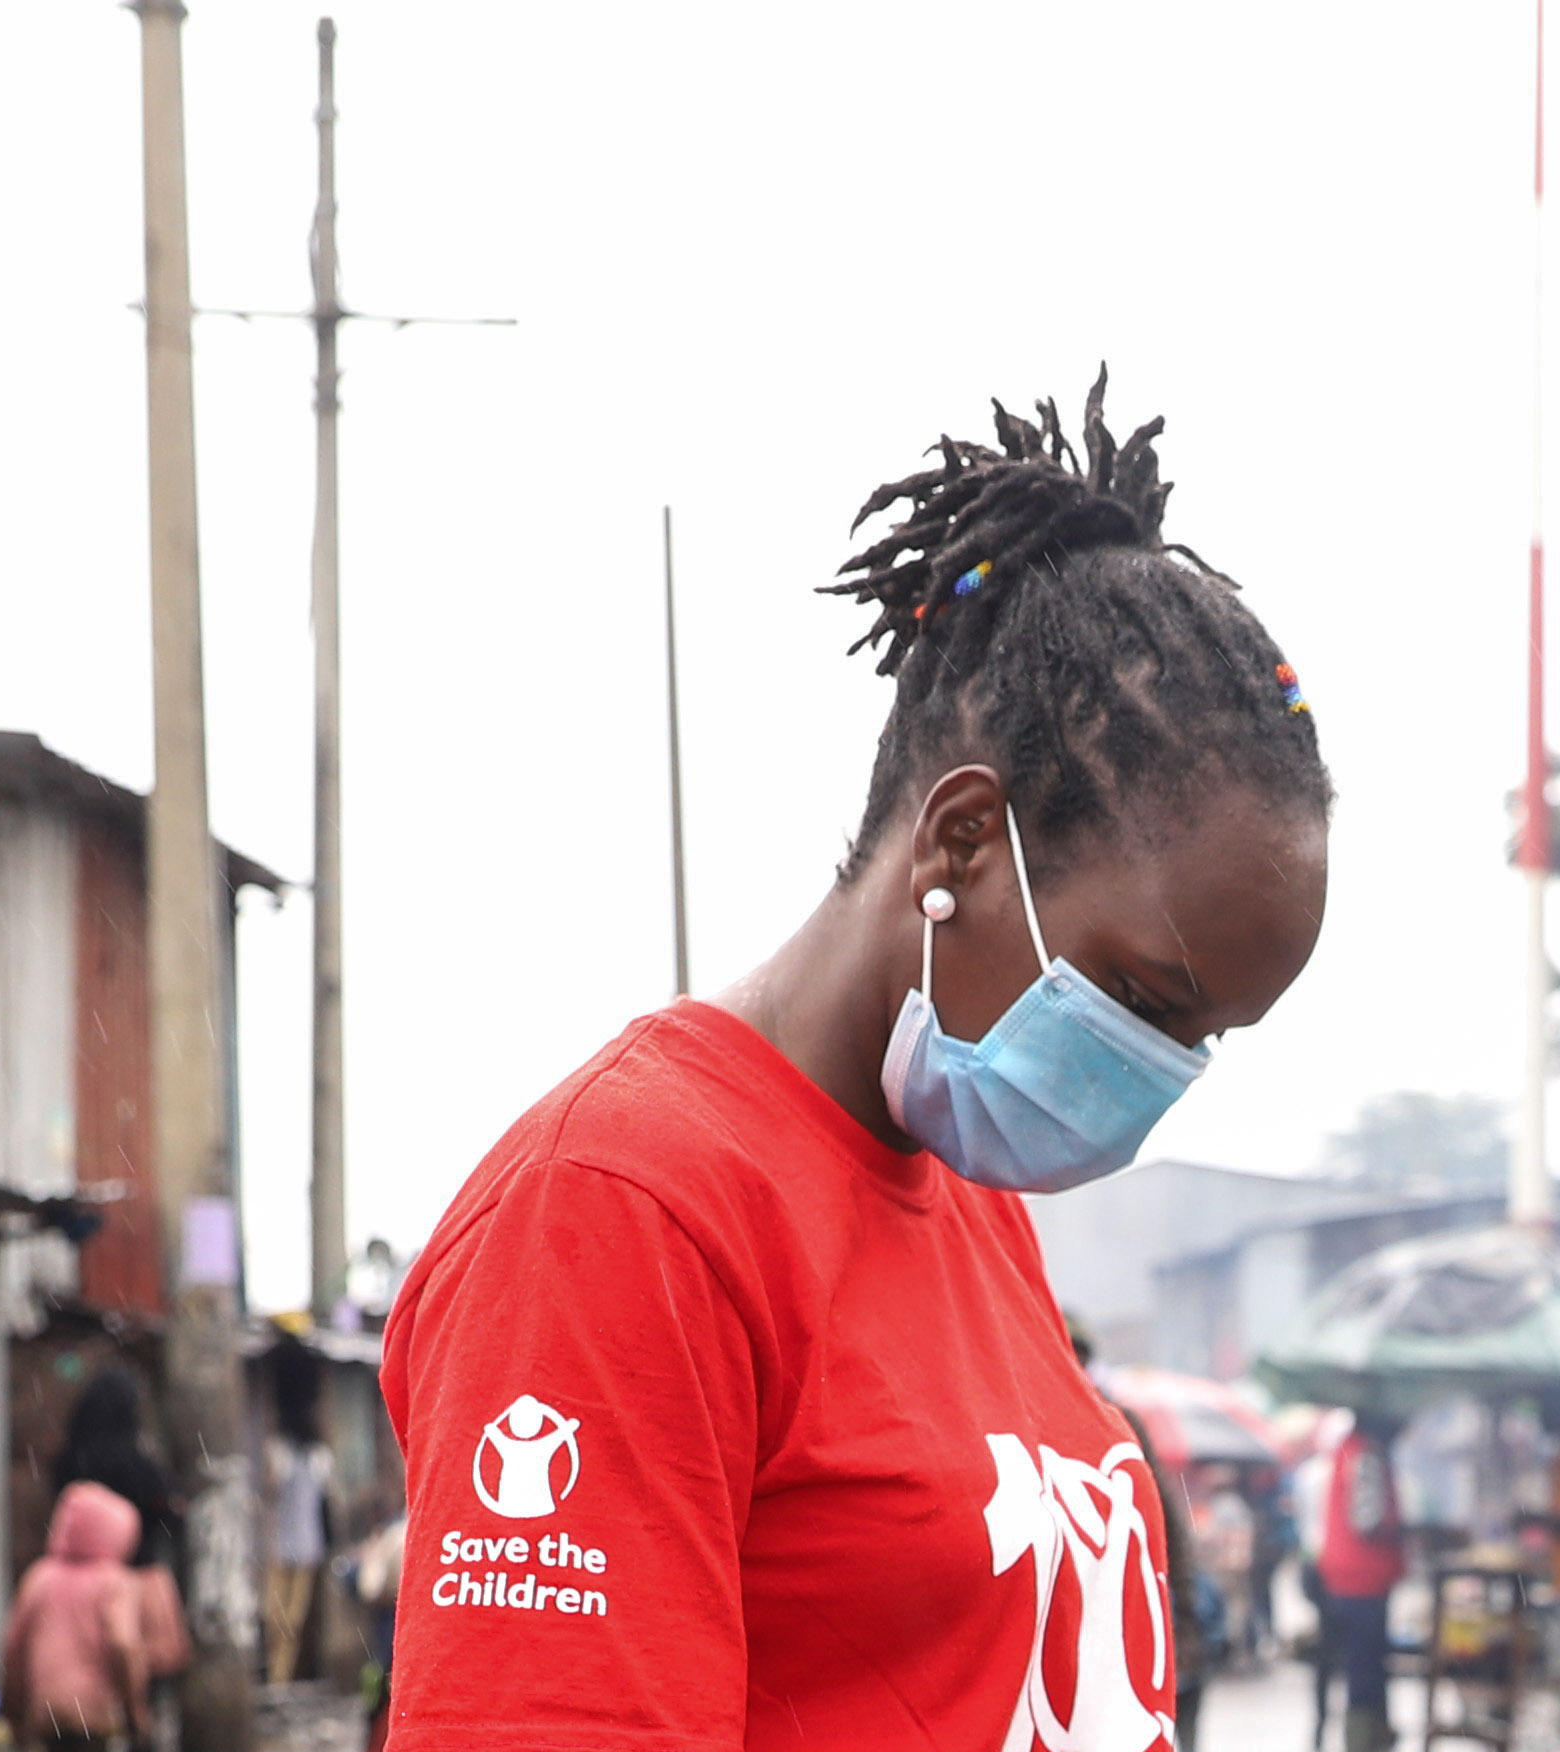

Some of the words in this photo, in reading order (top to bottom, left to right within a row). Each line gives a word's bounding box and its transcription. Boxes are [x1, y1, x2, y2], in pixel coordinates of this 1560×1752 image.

[440, 1531, 530, 1565] Save
[537, 1532, 608, 1574] the
[432, 1571, 608, 1616] Children
